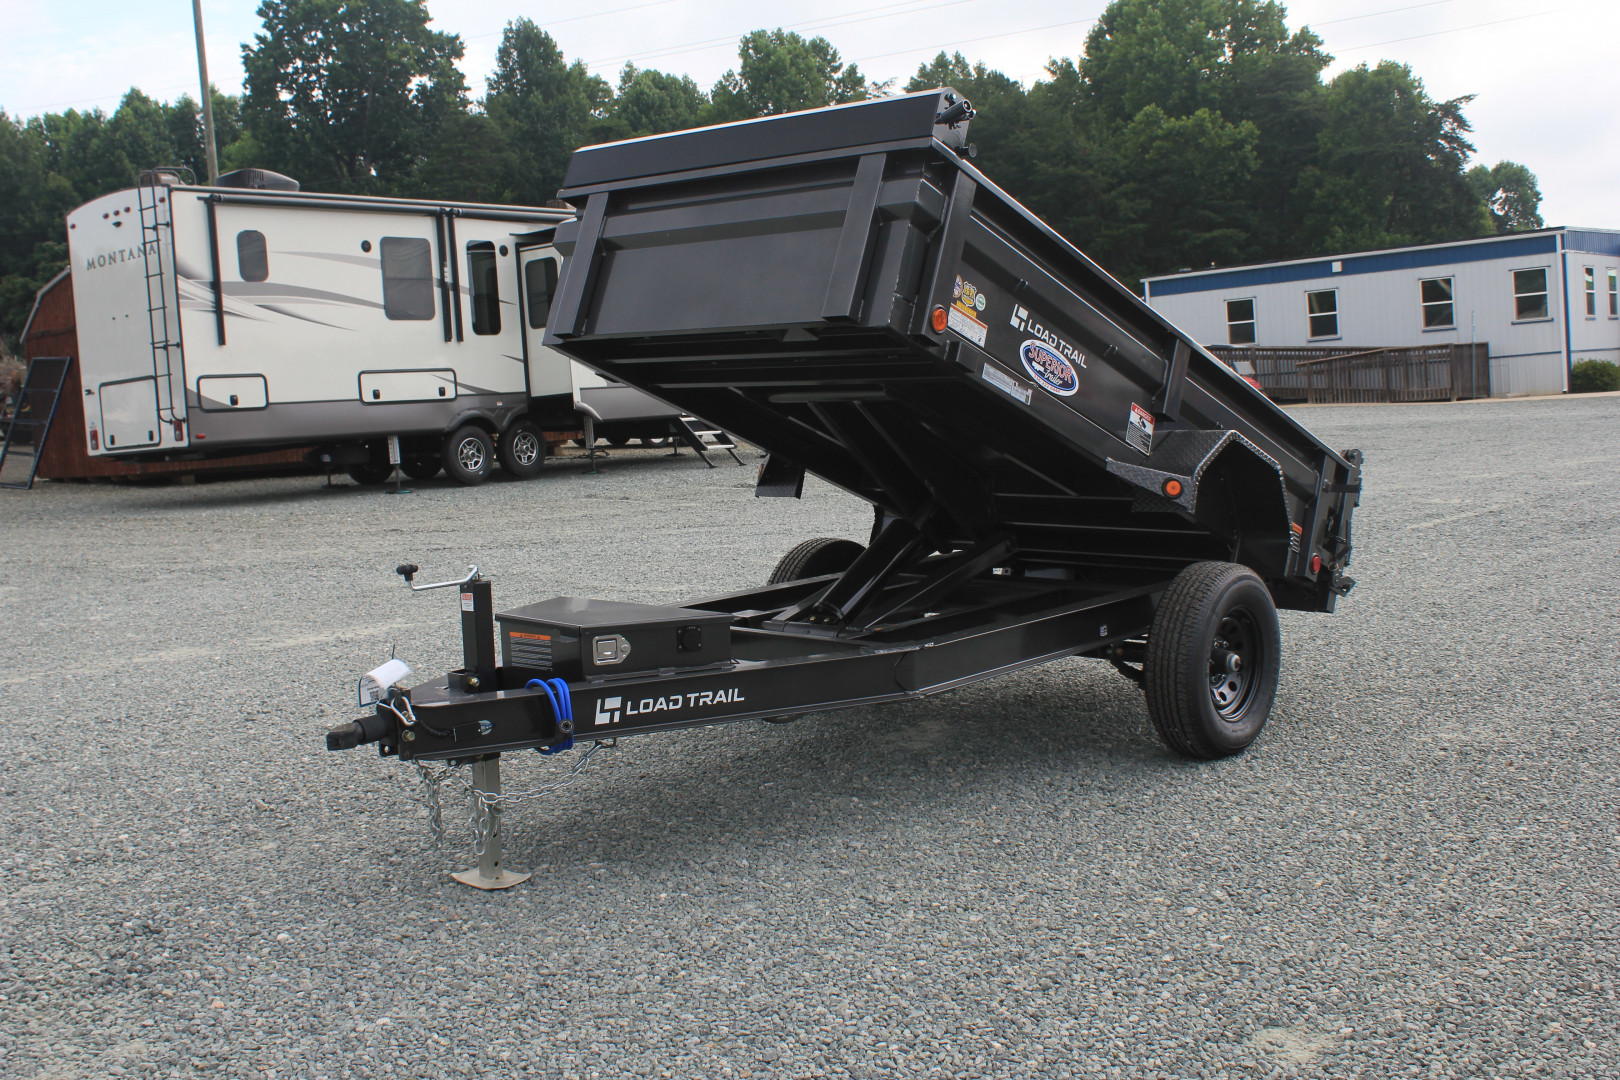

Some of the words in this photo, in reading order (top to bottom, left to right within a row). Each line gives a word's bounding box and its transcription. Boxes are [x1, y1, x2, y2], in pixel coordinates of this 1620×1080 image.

[86, 243, 157, 271] MONTANA
[1027, 318, 1058, 348] LOAD
[1059, 339, 1087, 369] TRAIL
[1028, 341, 1073, 384] SUPERIOR
[626, 694, 683, 716] LOAD
[686, 687, 745, 708] TRAIL
